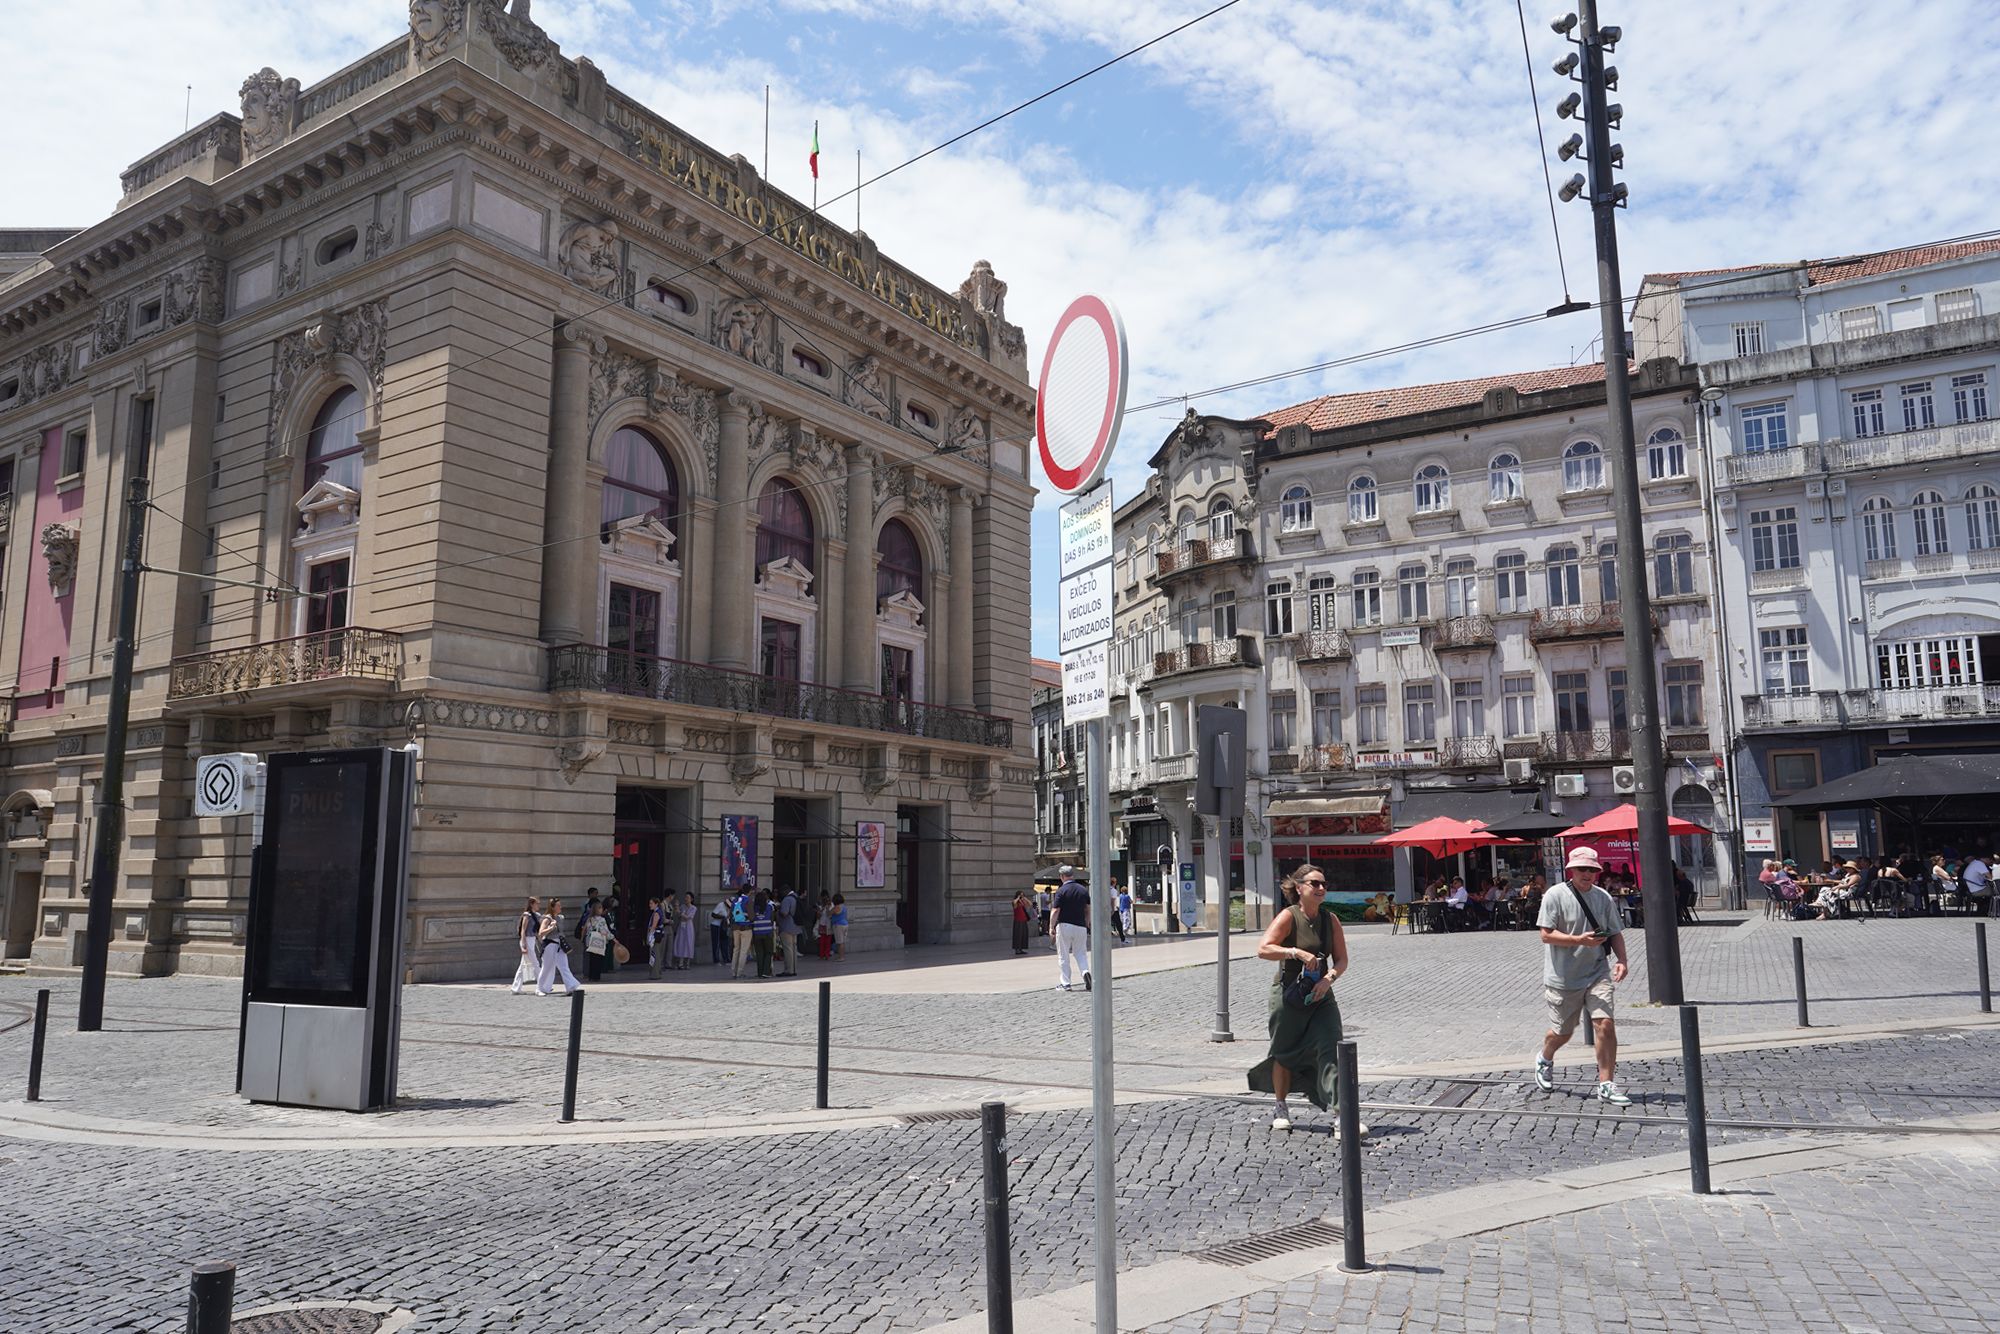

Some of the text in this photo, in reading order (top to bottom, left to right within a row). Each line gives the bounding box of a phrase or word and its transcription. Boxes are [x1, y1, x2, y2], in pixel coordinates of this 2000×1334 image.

[636, 131, 767, 227] TEATRO
[772, 207, 904, 310] NACIONAL
[1062, 496, 1109, 530] AOS SÁBADOS E
[1069, 518, 1101, 544] DOMINGOS
[1064, 549, 1076, 564] DAS
[1070, 579, 1097, 599] EXCETO
[1068, 598, 1102, 620] VEÍCULOS
[1312, 597, 1320, 629] CALISTA
[1326, 595, 1334, 628] SANTOS
[1062, 617, 1110, 643] AUTORIZADOS
[1067, 694, 1077, 706] DAS
[1078, 693, 1086, 703] 21
[1094, 688, 1104, 700] 24h
[289, 792, 344, 814] PMUS
